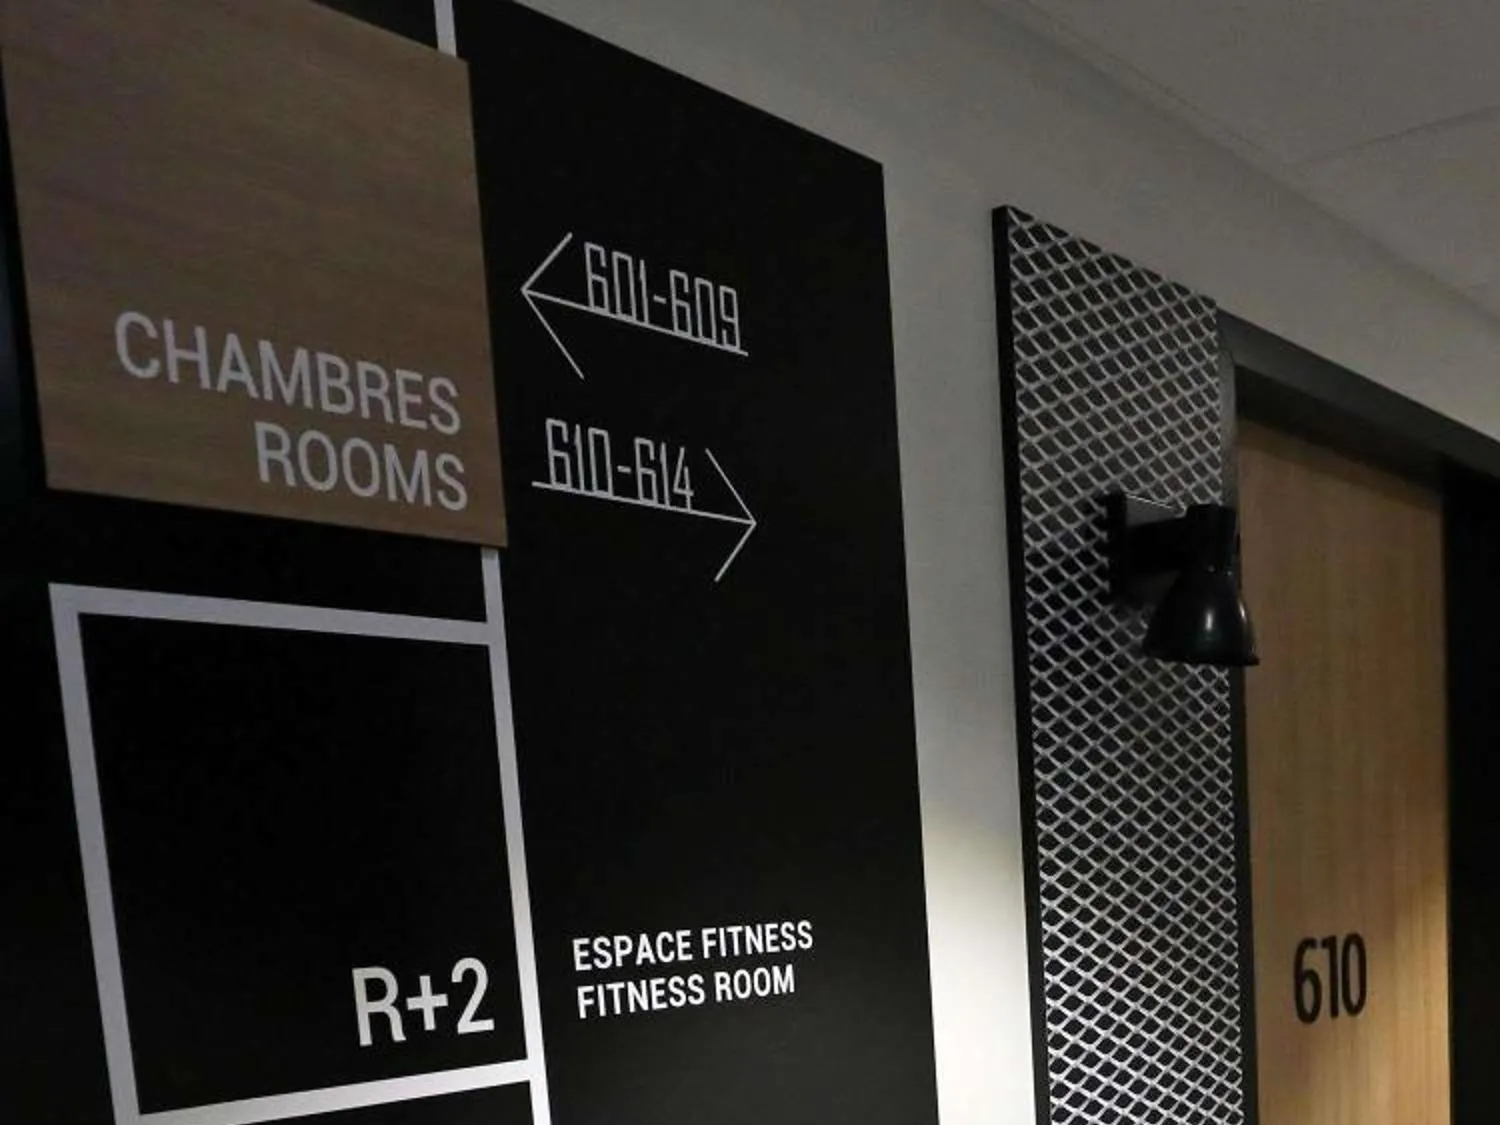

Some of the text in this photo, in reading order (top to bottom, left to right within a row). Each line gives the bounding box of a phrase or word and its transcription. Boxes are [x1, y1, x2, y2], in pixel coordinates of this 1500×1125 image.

[584, 242, 742, 350] 601-609
[116, 311, 462, 435] CHAMBRES
[254, 422, 468, 511] ROOMS
[545, 419, 694, 511] 610-614
[572, 920, 813, 971] ESPACE FITNESS
[1294, 933, 1367, 1024] 610
[352, 957, 495, 1046] R+2
[577, 964, 796, 1019] FITNESS ROOM
